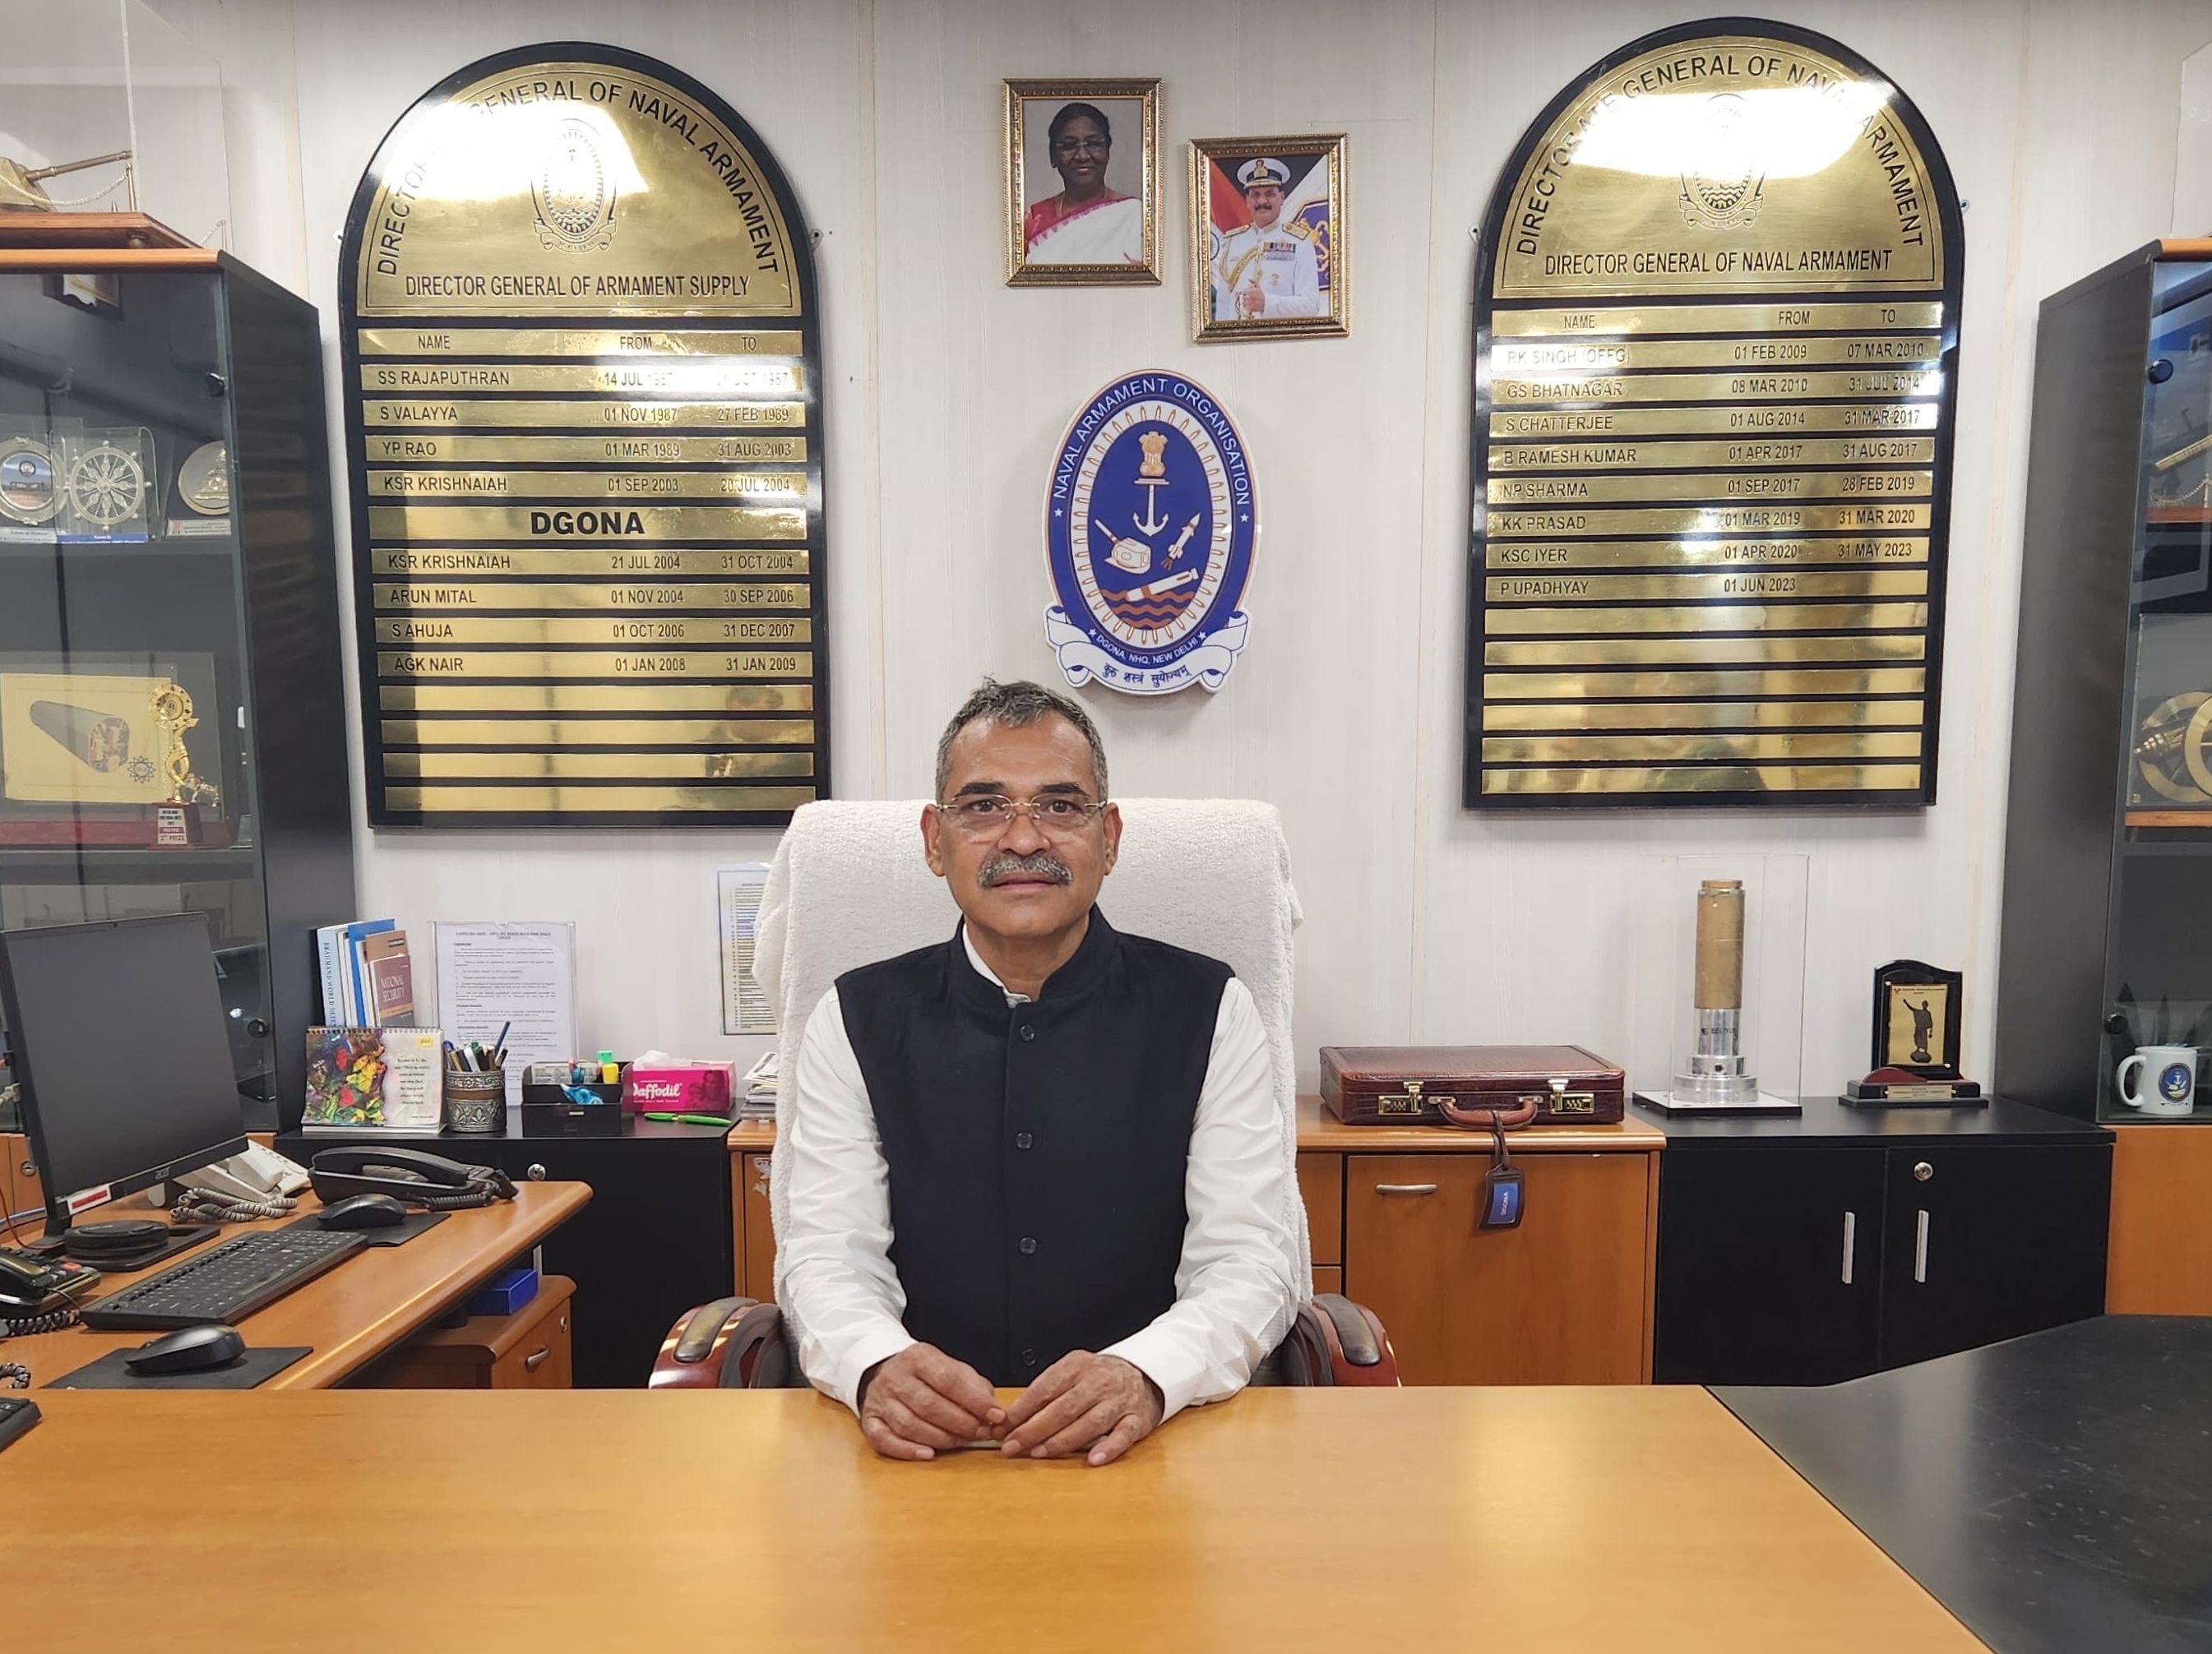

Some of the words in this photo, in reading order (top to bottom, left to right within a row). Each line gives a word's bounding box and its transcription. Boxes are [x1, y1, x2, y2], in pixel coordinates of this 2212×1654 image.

[1622, 55, 1740, 99] GENERAL
[1747, 56, 1781, 78] OF
[1858, 114, 1923, 247] ARMAMENT
[590, 81, 622, 104] OF
[628, 90, 701, 146] NAVAL
[699, 141, 779, 273] ARMAMENT
[1545, 254, 1628, 275] DIRECTOR
[1633, 253, 1710, 275] GENERAL
[1715, 252, 1739, 272] OF
[1742, 251, 1794, 272] NAVAL
[1798, 249, 1892, 271] ARMAMENT
[405, 276, 485, 297] DIRECTOR
[491, 276, 567, 297] GENERAL
[571, 275, 591, 297] OF
[595, 275, 685, 297] ARMAMENT
[690, 275, 750, 297] SUPPLY
[1564, 315, 1595, 329] NAME
[1779, 311, 1810, 326] FROM
[1881, 309, 1896, 323] TO
[418, 335, 451, 349] NAME
[620, 336, 652, 350] FROM
[742, 336, 757, 351] TO
[1533, 349, 1576, 364] SINGH
[1734, 346, 1747, 360] 01
[1752, 345, 1775, 359] FEB
[1779, 344, 1807, 359] 2009
[1848, 344, 1861, 358] 07
[1866, 344, 1893, 358] MAR
[1896, 343, 1923, 358] 2010
[378, 371, 396, 385] SS
[401, 371, 510, 386] RAJAPUTHRAN
[604, 372, 617, 386] 14
[621, 372, 644, 386] JUL
[1507, 384, 1527, 398] GS
[1532, 382, 1623, 398] BHATNAGAR
[1732, 379, 1745, 393] 08
[1749, 379, 1777, 393] MAR
[1780, 378, 1807, 392] 2010
[380, 407, 389, 420] S
[393, 406, 458, 421] VALAYYA
[604, 408, 617, 422] 01
[621, 408, 647, 422] NOV
[653, 408, 678, 421] 1987
[1506, 418, 1515, 432] S
[1519, 416, 1613, 432] CHATTERJEE
[1730, 413, 1742, 427] 01
[1747, 412, 1775, 427] AUG
[1778, 412, 1805, 426] 2014
[382, 441, 400, 455] YP
[405, 442, 437, 456] RAO
[605, 443, 618, 457] 01
[622, 443, 650, 457] MAR
[654, 443, 680, 457] 1989
[1053, 445, 1083, 499] NAVAL
[1080, 378, 1168, 444] ARMAMENT
[1173, 383, 1250, 505] ORGANISATION
[1504, 451, 1514, 464] B
[1519, 450, 1580, 464] RAMESH
[1584, 449, 1636, 464] KUMAR
[1729, 446, 1742, 460] 01
[1746, 446, 1772, 460] APR
[1775, 446, 1802, 460] 2017
[1843, 445, 1855, 458] 31
[1860, 444, 1887, 458] AUG
[1890, 443, 1918, 457] 2017
[384, 477, 413, 491] KSR
[418, 477, 507, 492] KRISHNAIAH
[608, 478, 620, 492] 01
[625, 478, 649, 492] SEP
[652, 478, 679, 492] 2003
[1503, 483, 1522, 498] NP
[1525, 483, 1589, 497] SHARMA
[1728, 479, 1741, 493] 01
[1745, 479, 1769, 493] SEP
[1773, 478, 1800, 492] 2017
[1842, 478, 1856, 492] 28
[1859, 477, 1884, 491] FEB
[1887, 476, 1915, 491] 2019
[530, 511, 645, 534] DGONA
[1502, 517, 1522, 530] KK
[1527, 516, 1586, 530] PRASAD
[1839, 511, 1852, 524] 31
[1856, 511, 1884, 524] MAR
[1887, 510, 1915, 524] 2020
[388, 555, 418, 569] KSR
[423, 555, 511, 570] KRISHNAIAH
[612, 556, 624, 569] 21
[628, 556, 650, 570] JUL
[654, 556, 680, 570] 2004
[721, 556, 733, 569] 31
[738, 556, 763, 569] OCT
[766, 555, 793, 569] 2004
[1501, 549, 1530, 562] KSC
[1534, 548, 1567, 562] IYER
[1725, 546, 1738, 560] 01
[1742, 545, 1767, 559] APR
[1770, 544, 1798, 559] 2020
[1838, 543, 1850, 557] 31
[1855, 543, 1882, 557] MAY
[1885, 543, 1912, 557] 2023
[391, 589, 430, 603] ARUN
[435, 589, 477, 603] MITAL
[611, 590, 623, 603] 01
[628, 589, 654, 603] NOV
[657, 589, 684, 603] 2004
[724, 589, 737, 603] 30
[740, 589, 764, 603] SEP
[766, 589, 794, 603] 2006
[1501, 582, 1510, 595] P
[1513, 580, 1590, 596] UPADHYAY
[1724, 579, 1737, 593] 01
[1741, 578, 1765, 593] JUN
[1769, 578, 1796, 592] 2023
[392, 624, 401, 637] S
[405, 624, 453, 638] AHUJA
[613, 625, 625, 638] 01
[629, 624, 655, 638] OCT
[658, 624, 685, 638] 2006
[724, 624, 736, 637] 31
[740, 624, 766, 637] DEC
[769, 624, 795, 637] 2007
[1153, 652, 1173, 664] NEW
[1173, 638, 1198, 658] DELHI
[395, 658, 426, 672] AGK
[429, 658, 464, 672] NAIR
[615, 658, 627, 672] 01
[632, 658, 655, 672] JAN
[659, 658, 686, 672] 2008
[726, 658, 738, 671] 31
[743, 658, 766, 671] JAN
[770, 658, 796, 671] 2009
